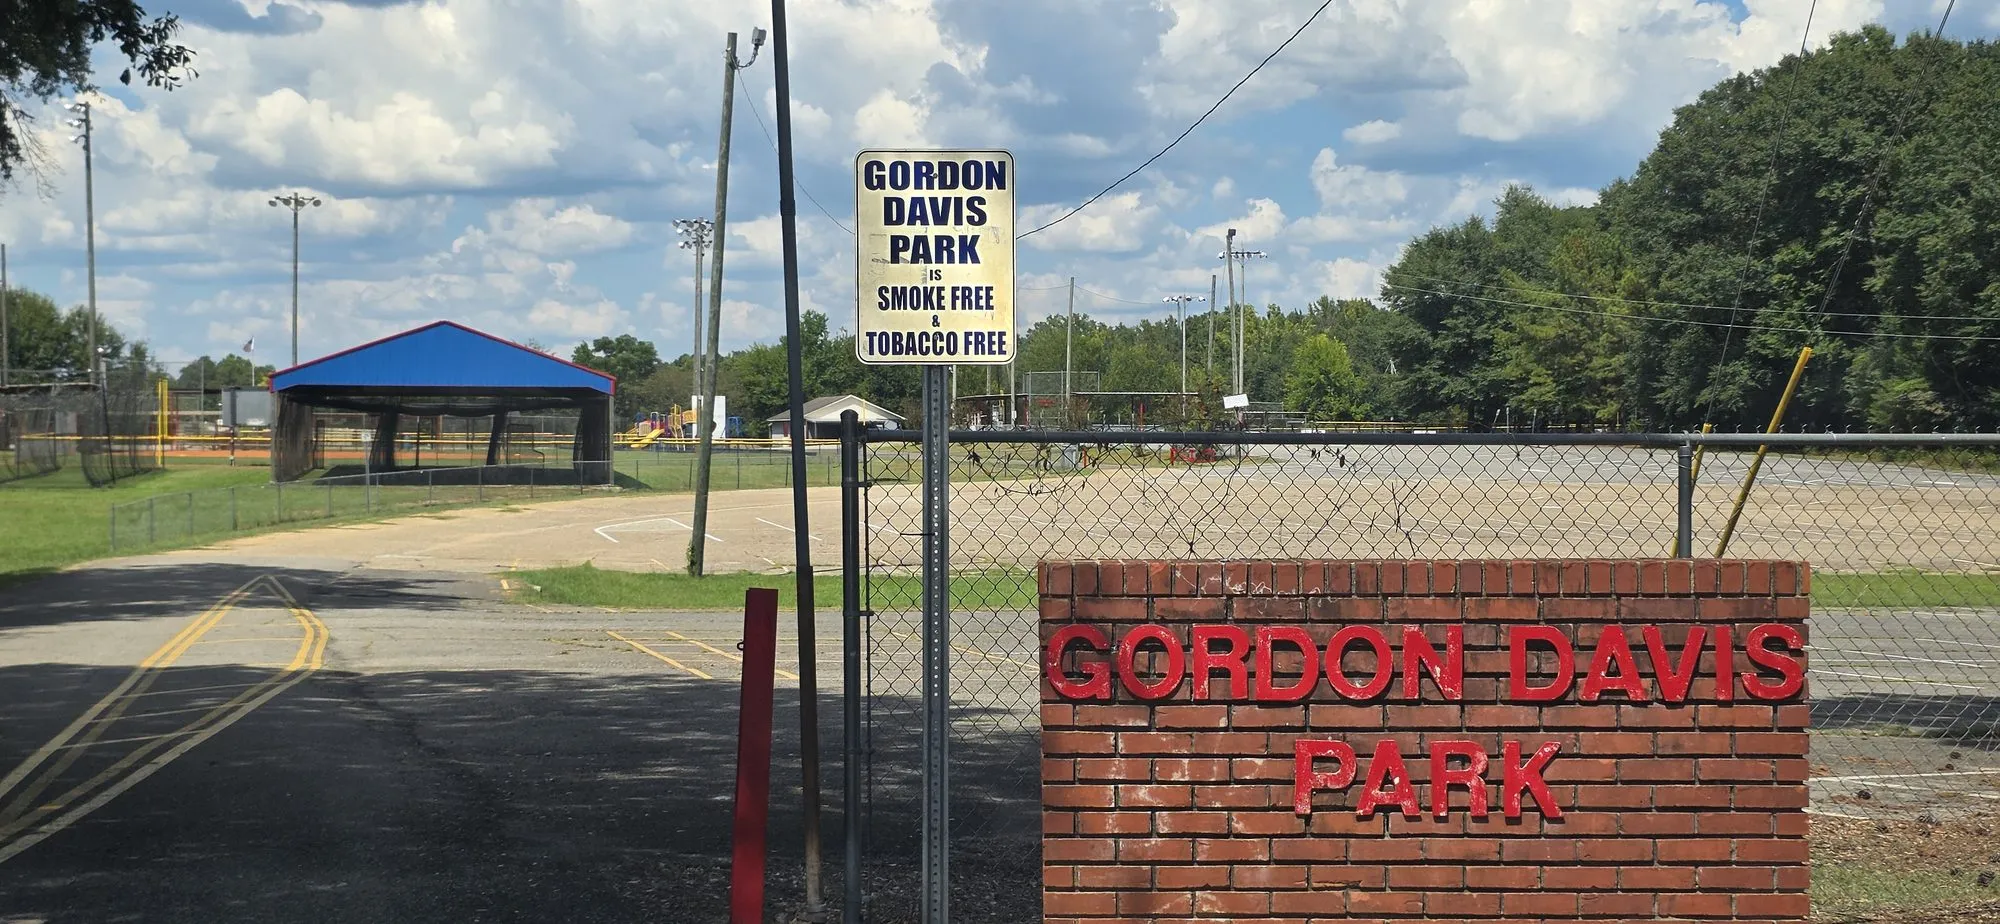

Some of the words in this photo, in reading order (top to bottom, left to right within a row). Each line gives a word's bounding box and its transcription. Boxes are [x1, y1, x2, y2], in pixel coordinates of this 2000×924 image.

[864, 160, 1007, 190] GORDON
[883, 196, 987, 226] DAVIS
[890, 234, 981, 264] PARK
[929, 269, 942, 281] IS
[878, 285, 945, 310] SMOKE
[951, 286, 994, 310] FREE
[932, 314, 940, 327] &
[866, 331, 958, 355] TOBACCO
[964, 332, 1007, 355] FREE
[1046, 623, 1465, 701] GORDON
[1509, 623, 1805, 703] DAVIS
[1294, 739, 1565, 819] PARK
